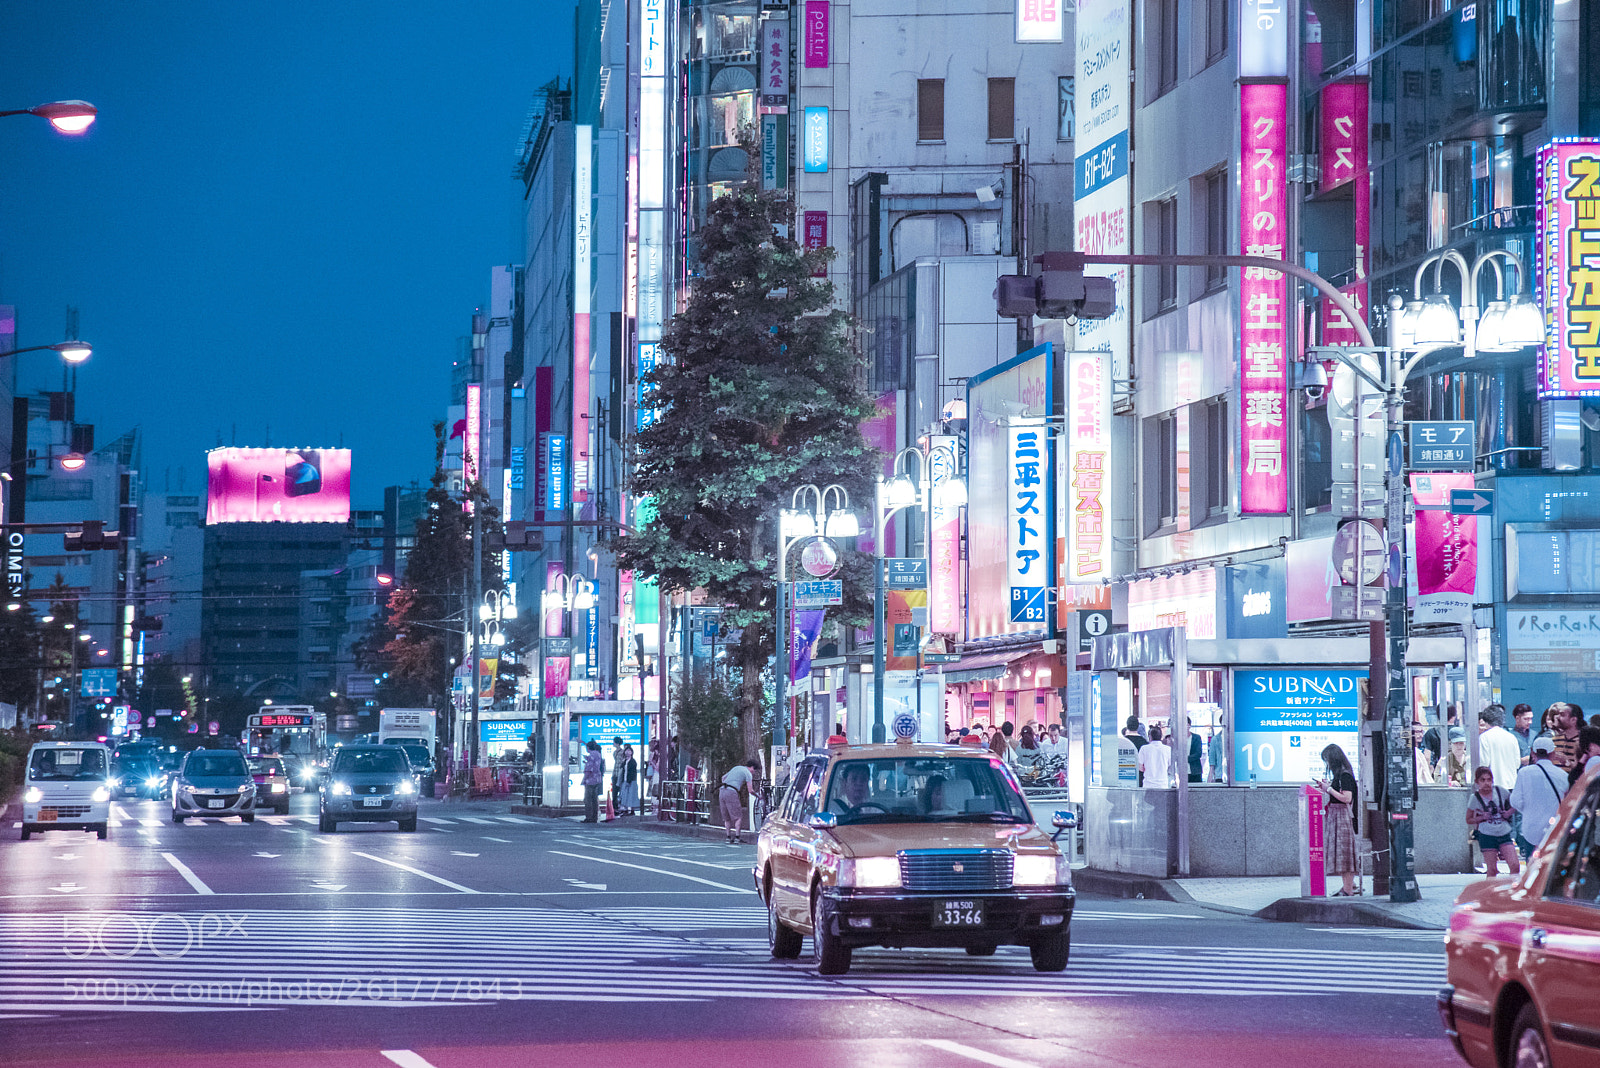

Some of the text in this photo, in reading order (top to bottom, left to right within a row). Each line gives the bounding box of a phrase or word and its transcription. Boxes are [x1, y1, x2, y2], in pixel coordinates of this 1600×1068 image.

[1257, 0, 1280, 30] le
[810, 11, 825, 57] partir
[768, 96, 783, 104] 3F
[766, 122, 776, 180] FamilyMart
[578, 213, 590, 263] ピカデリー
[1077, 362, 1095, 439] GAME
[552, 438, 562, 446] 4
[1420, 428, 1466, 443] モア
[551, 446, 562, 475] ISETAN
[1421, 450, 1464, 460] 靖国通り
[511, 447, 524, 489] ISETAN
[574, 460, 588, 492] MUJI
[553, 492, 561, 509] PARK
[1015, 431, 1041, 576] 三平ストア
[894, 562, 922, 572] モア
[1013, 588, 1028, 601] B1
[1026, 607, 1043, 620] B2
[1254, 676, 1358, 696] SUBNAD
[1286, 697, 1336, 705] 新宿サブナード
[116, 708, 124, 718] P
[1241, 742, 1276, 771] 10
[944, 910, 981, 924] 33-66
